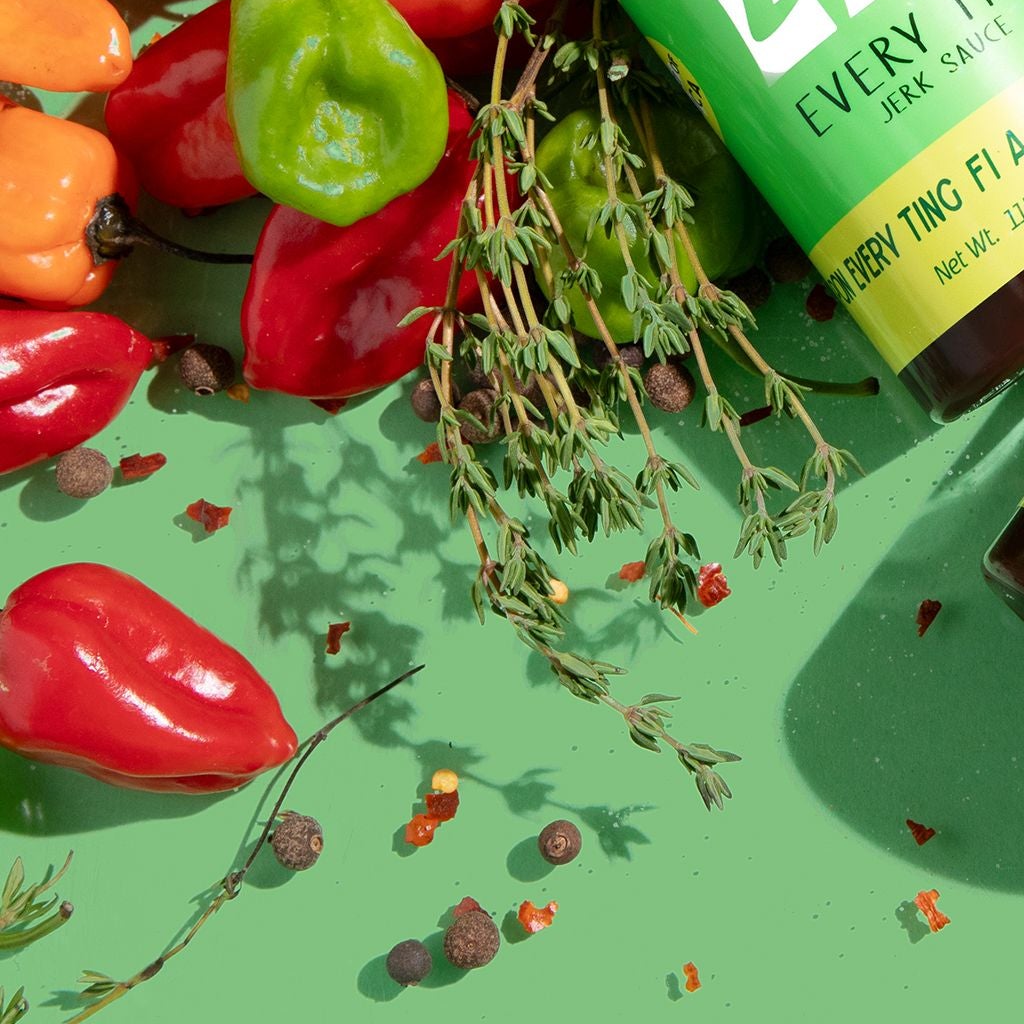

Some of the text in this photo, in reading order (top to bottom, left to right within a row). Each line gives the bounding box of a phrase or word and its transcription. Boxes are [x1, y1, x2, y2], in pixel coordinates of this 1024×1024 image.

[795, 12, 928, 138] EVERY
[878, 15, 1013, 124] JERK SAUCE
[843, 223, 900, 291] EVERY
[897, 178, 963, 242] TING
[965, 148, 1001, 192] FI
[933, 251, 968, 286] Net
[966, 227, 1000, 259] Wt.
